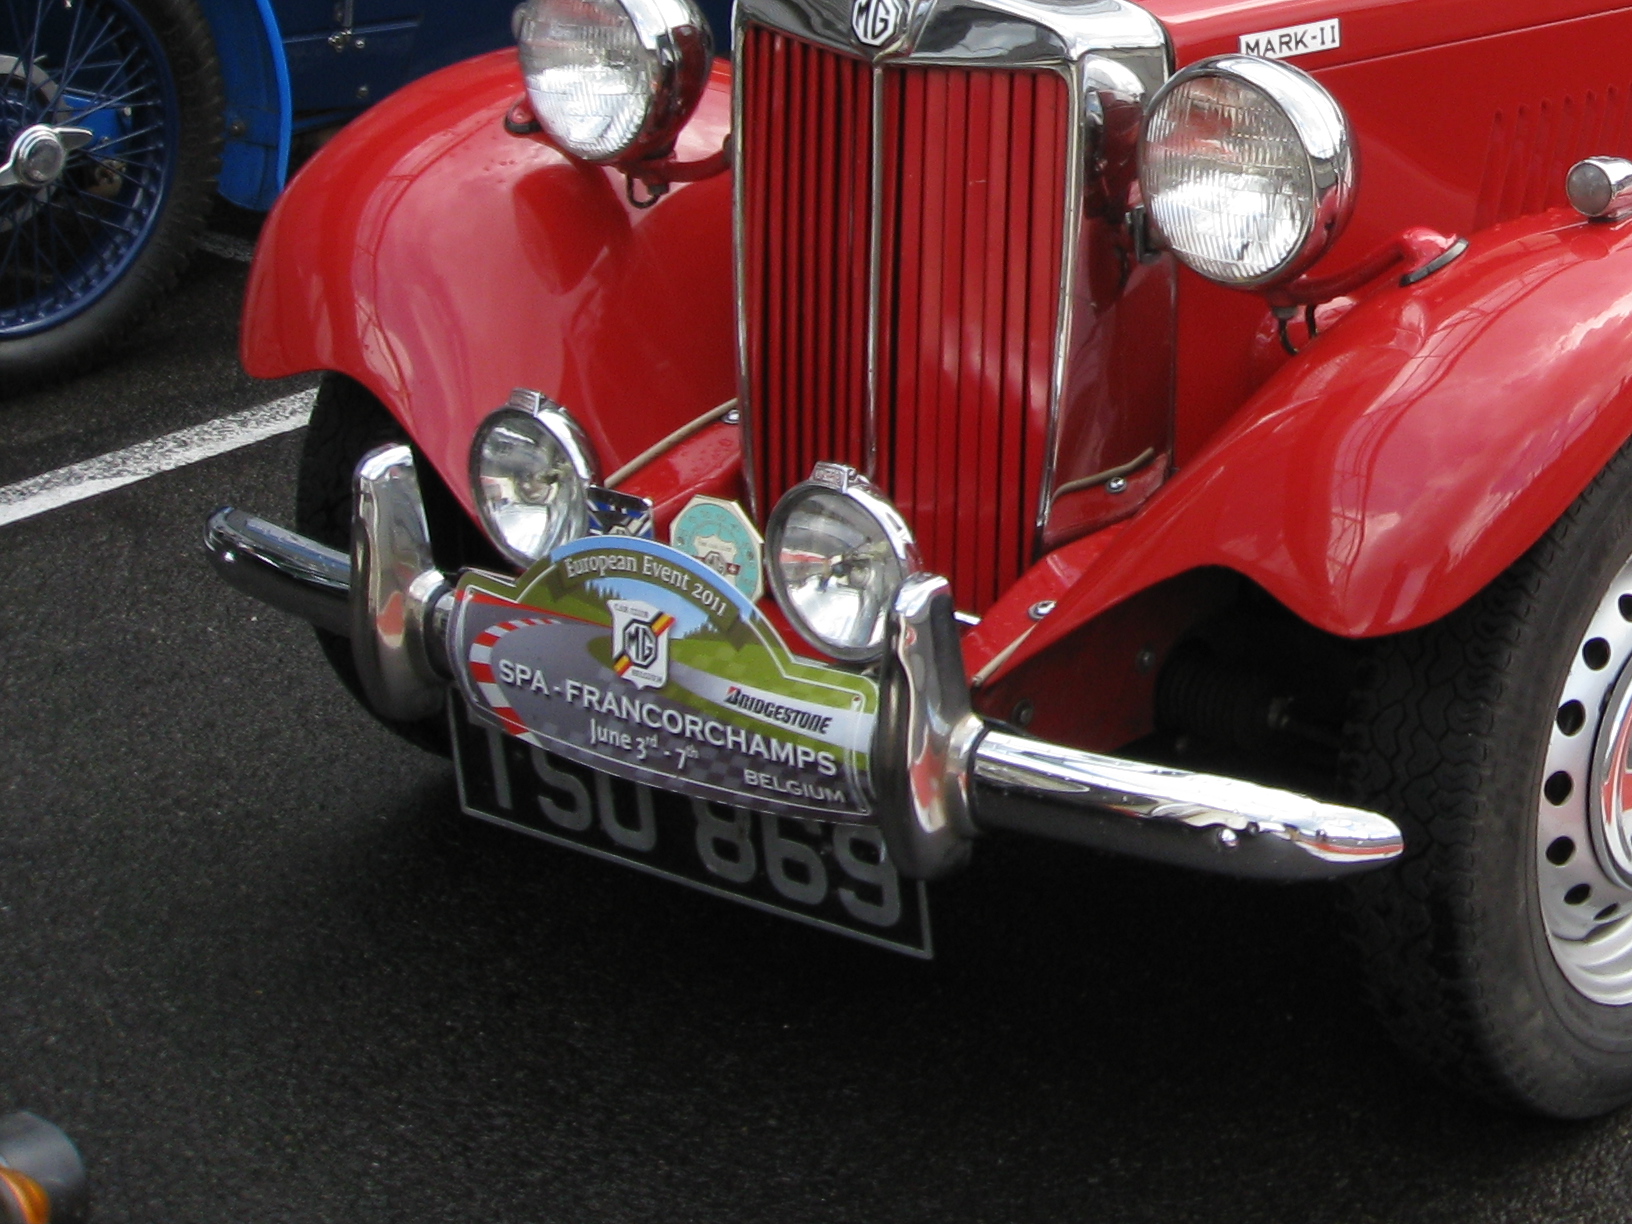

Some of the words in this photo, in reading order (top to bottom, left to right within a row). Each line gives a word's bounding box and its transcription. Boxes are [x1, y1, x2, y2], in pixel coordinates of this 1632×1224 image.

[1244, 25, 1336, 56] MARK-II
[564, 554, 638, 578] European
[642, 555, 689, 591] Event
[691, 583, 727, 617] 2011
[625, 623, 655, 665] MG
[499, 658, 550, 696] SPA
[565, 678, 838, 776] FRANCORCHAMPS
[723, 685, 833, 735] BRIDGESTONE
[589, 718, 633, 751] June
[635, 733, 659, 760] 3rd
[674, 743, 699, 770] 7th
[743, 768, 847, 804] BELGIUM
[694, 795, 901, 928] 869
